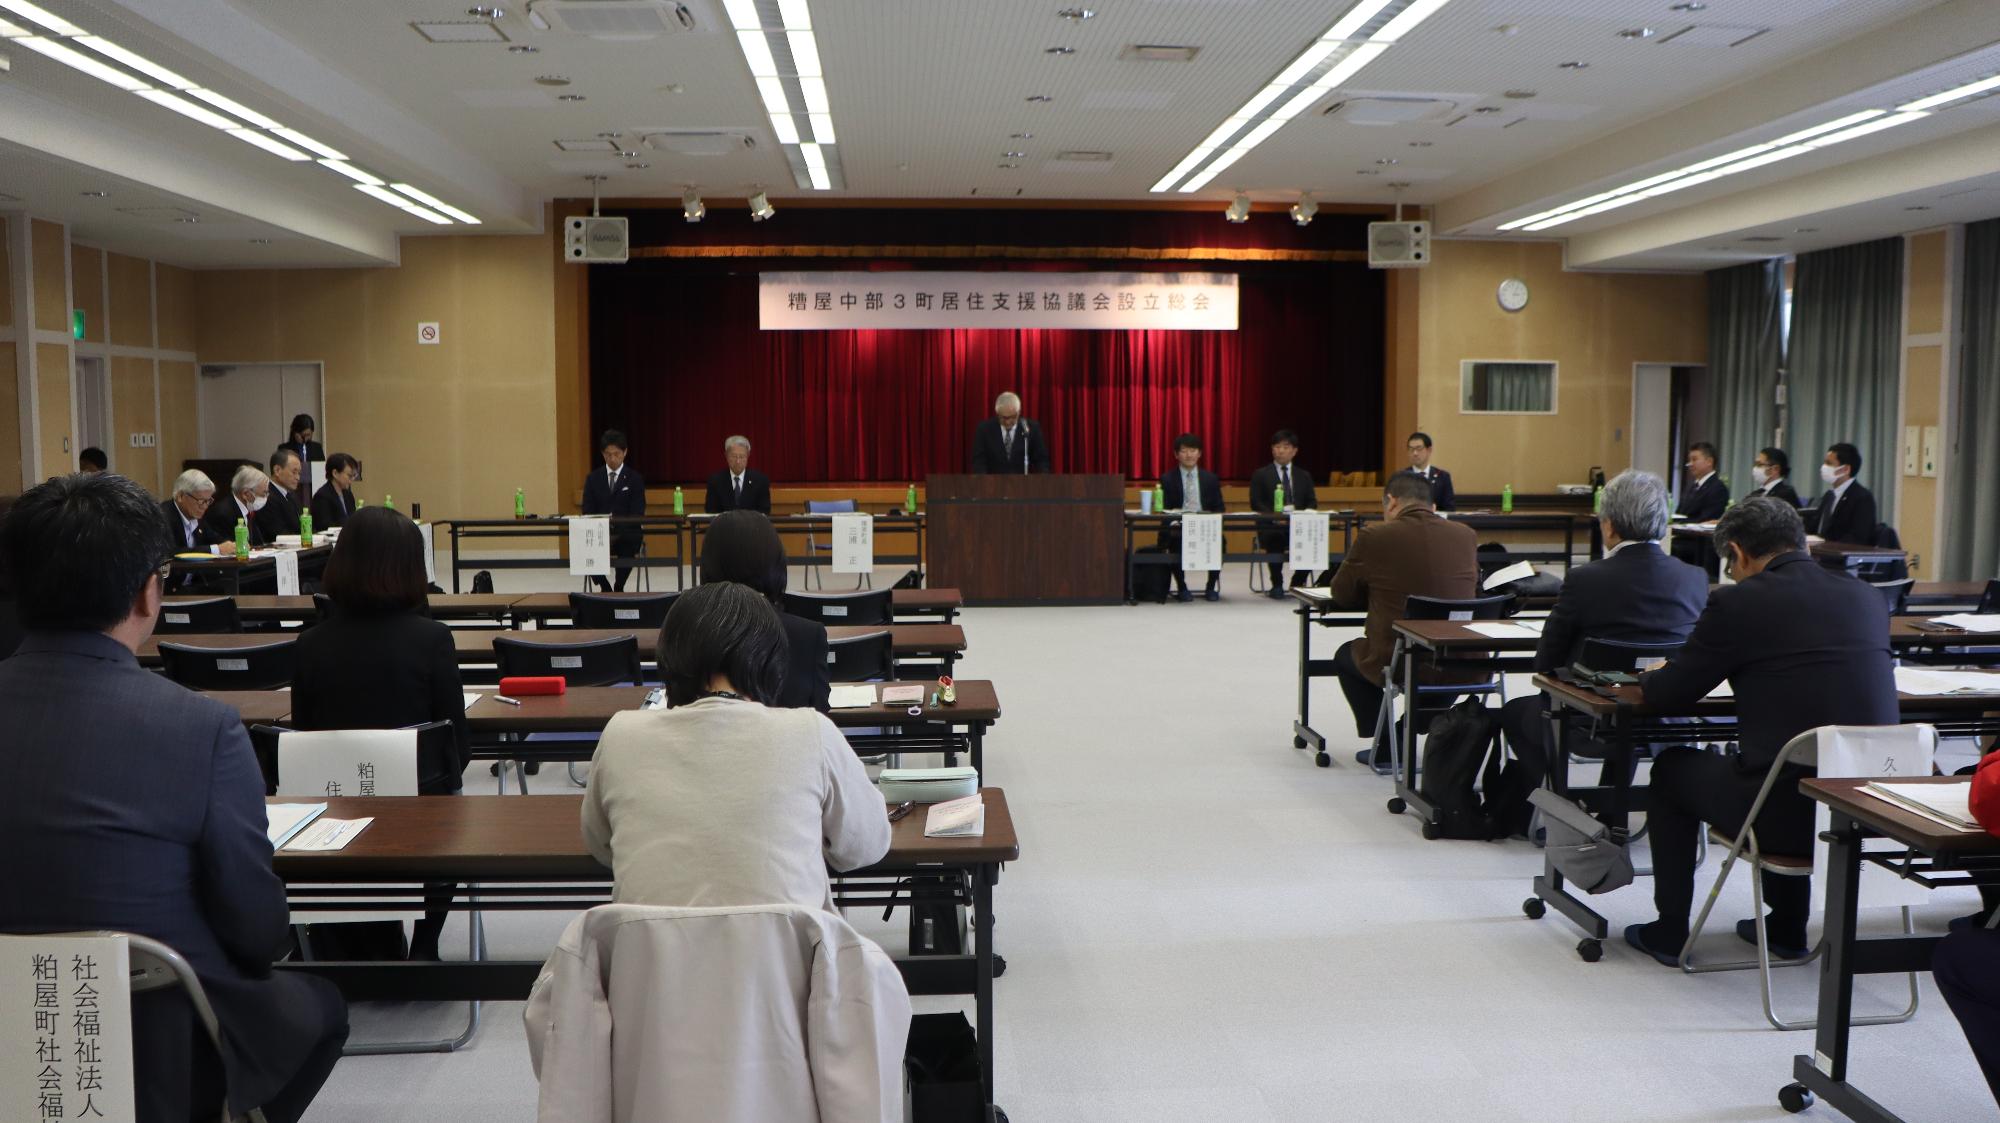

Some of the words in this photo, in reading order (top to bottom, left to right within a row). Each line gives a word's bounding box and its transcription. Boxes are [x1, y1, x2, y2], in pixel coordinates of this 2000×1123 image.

[357, 762, 376, 796] 粕屋
[1881, 756, 1897, 776] 久
[31, 953, 64, 1123] 粕屋町社会福
[71, 954, 104, 1118] 社会福祉法人
